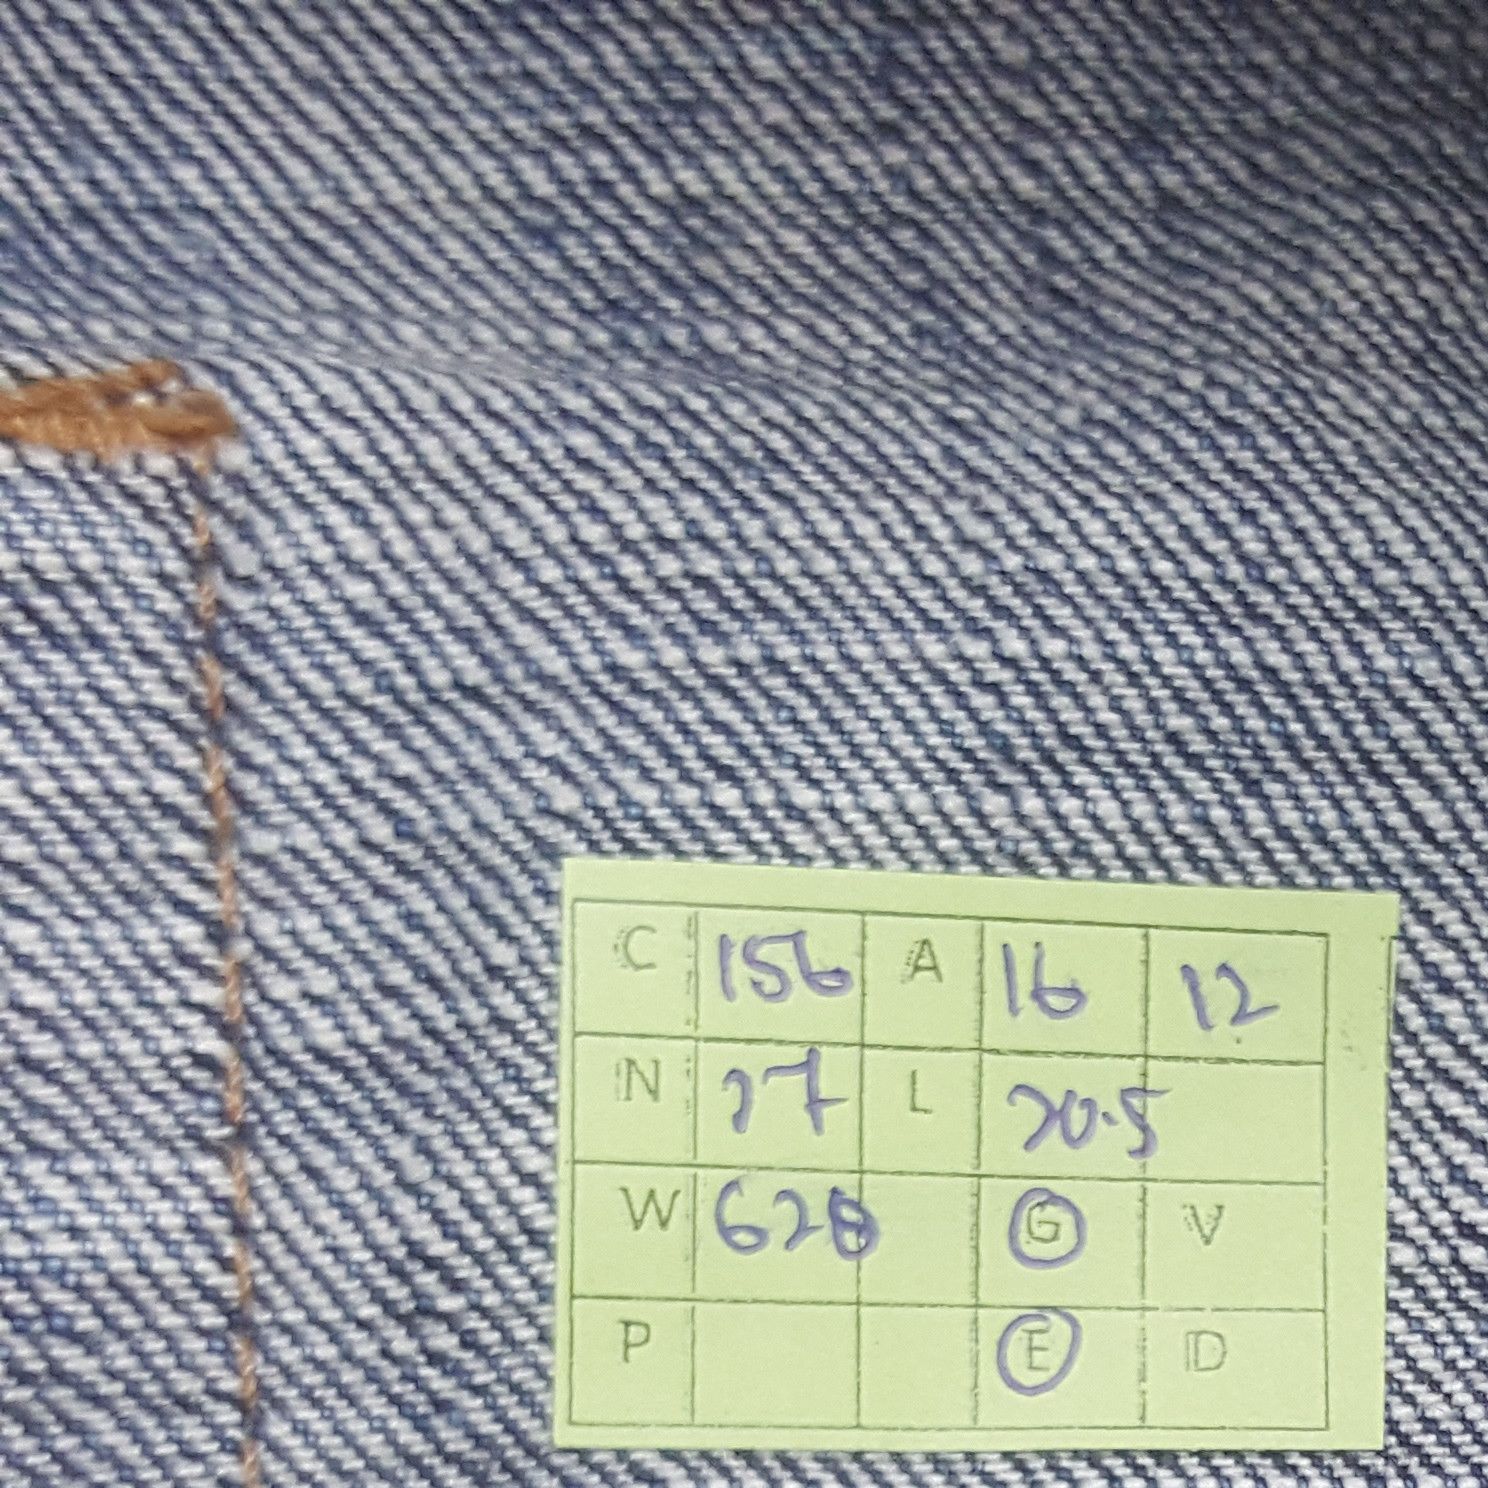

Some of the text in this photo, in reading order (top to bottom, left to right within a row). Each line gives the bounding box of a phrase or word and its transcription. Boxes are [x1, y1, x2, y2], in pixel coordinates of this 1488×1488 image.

[614, 925, 1280, 1030] C 156 A 16 12
[615, 1058, 660, 1102] N
[910, 1069, 933, 1114] L
[619, 1187, 680, 1231] W
[1182, 1204, 1225, 1246] V
[620, 1319, 650, 1363] P
[1186, 1330, 1227, 1371] D
